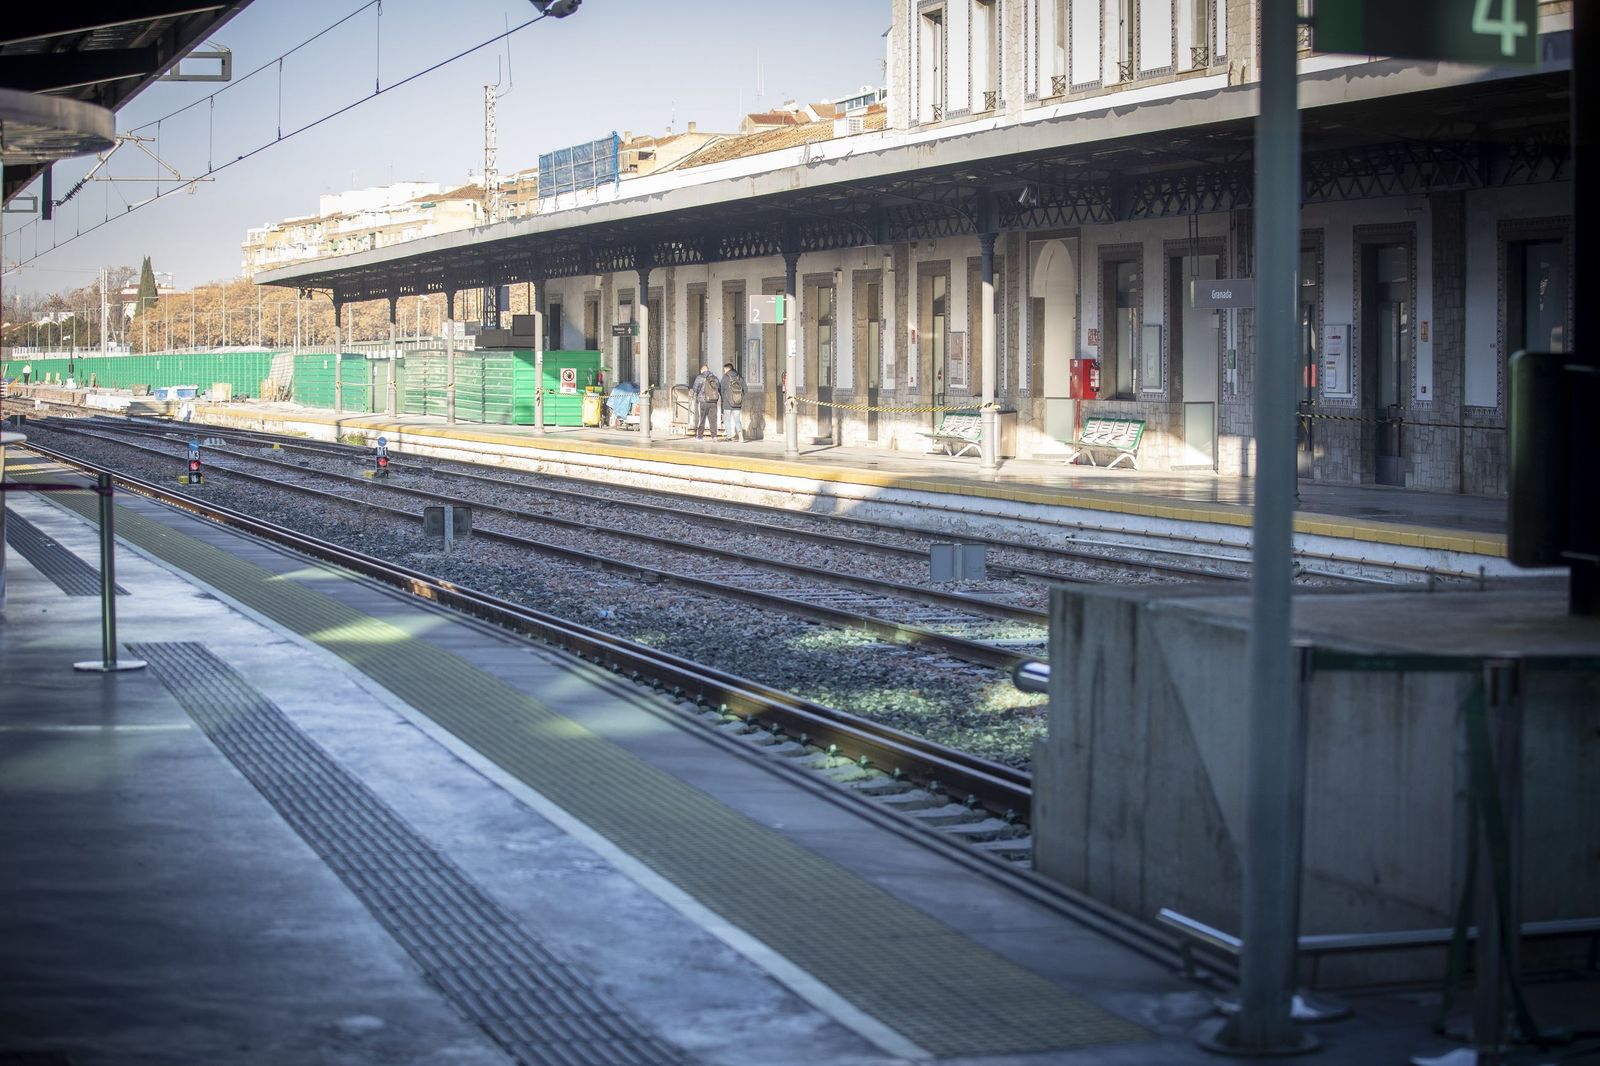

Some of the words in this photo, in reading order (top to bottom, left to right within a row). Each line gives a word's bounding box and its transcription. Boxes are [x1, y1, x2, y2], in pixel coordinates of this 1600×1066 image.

[1471, 0, 1528, 57] 4
[1211, 286, 1233, 300] Granada
[752, 308, 761, 322] 2
[188, 449, 200, 460] M3
[376, 446, 387, 456] M1
